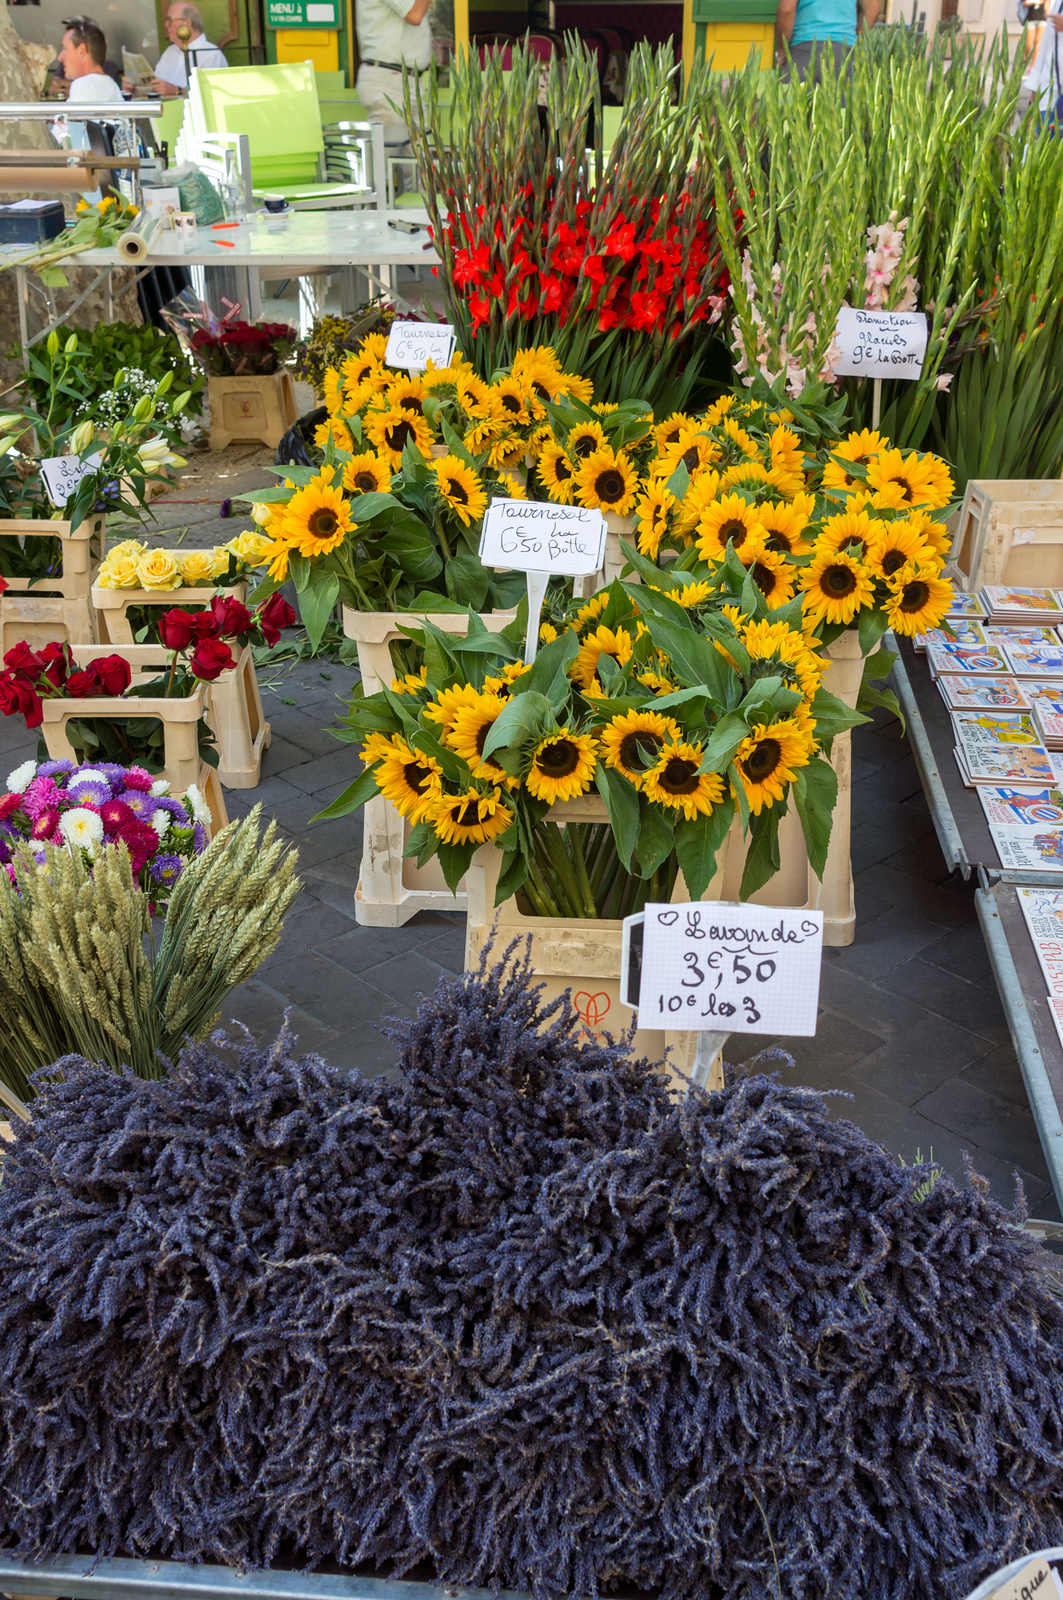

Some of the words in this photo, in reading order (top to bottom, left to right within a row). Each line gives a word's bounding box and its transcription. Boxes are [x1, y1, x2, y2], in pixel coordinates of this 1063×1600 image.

[270, 3, 295, 14] MENU
[296, 3, 303, 14] à
[685, 911, 804, 943] Lavande
[743, 996, 761, 1025] 3
